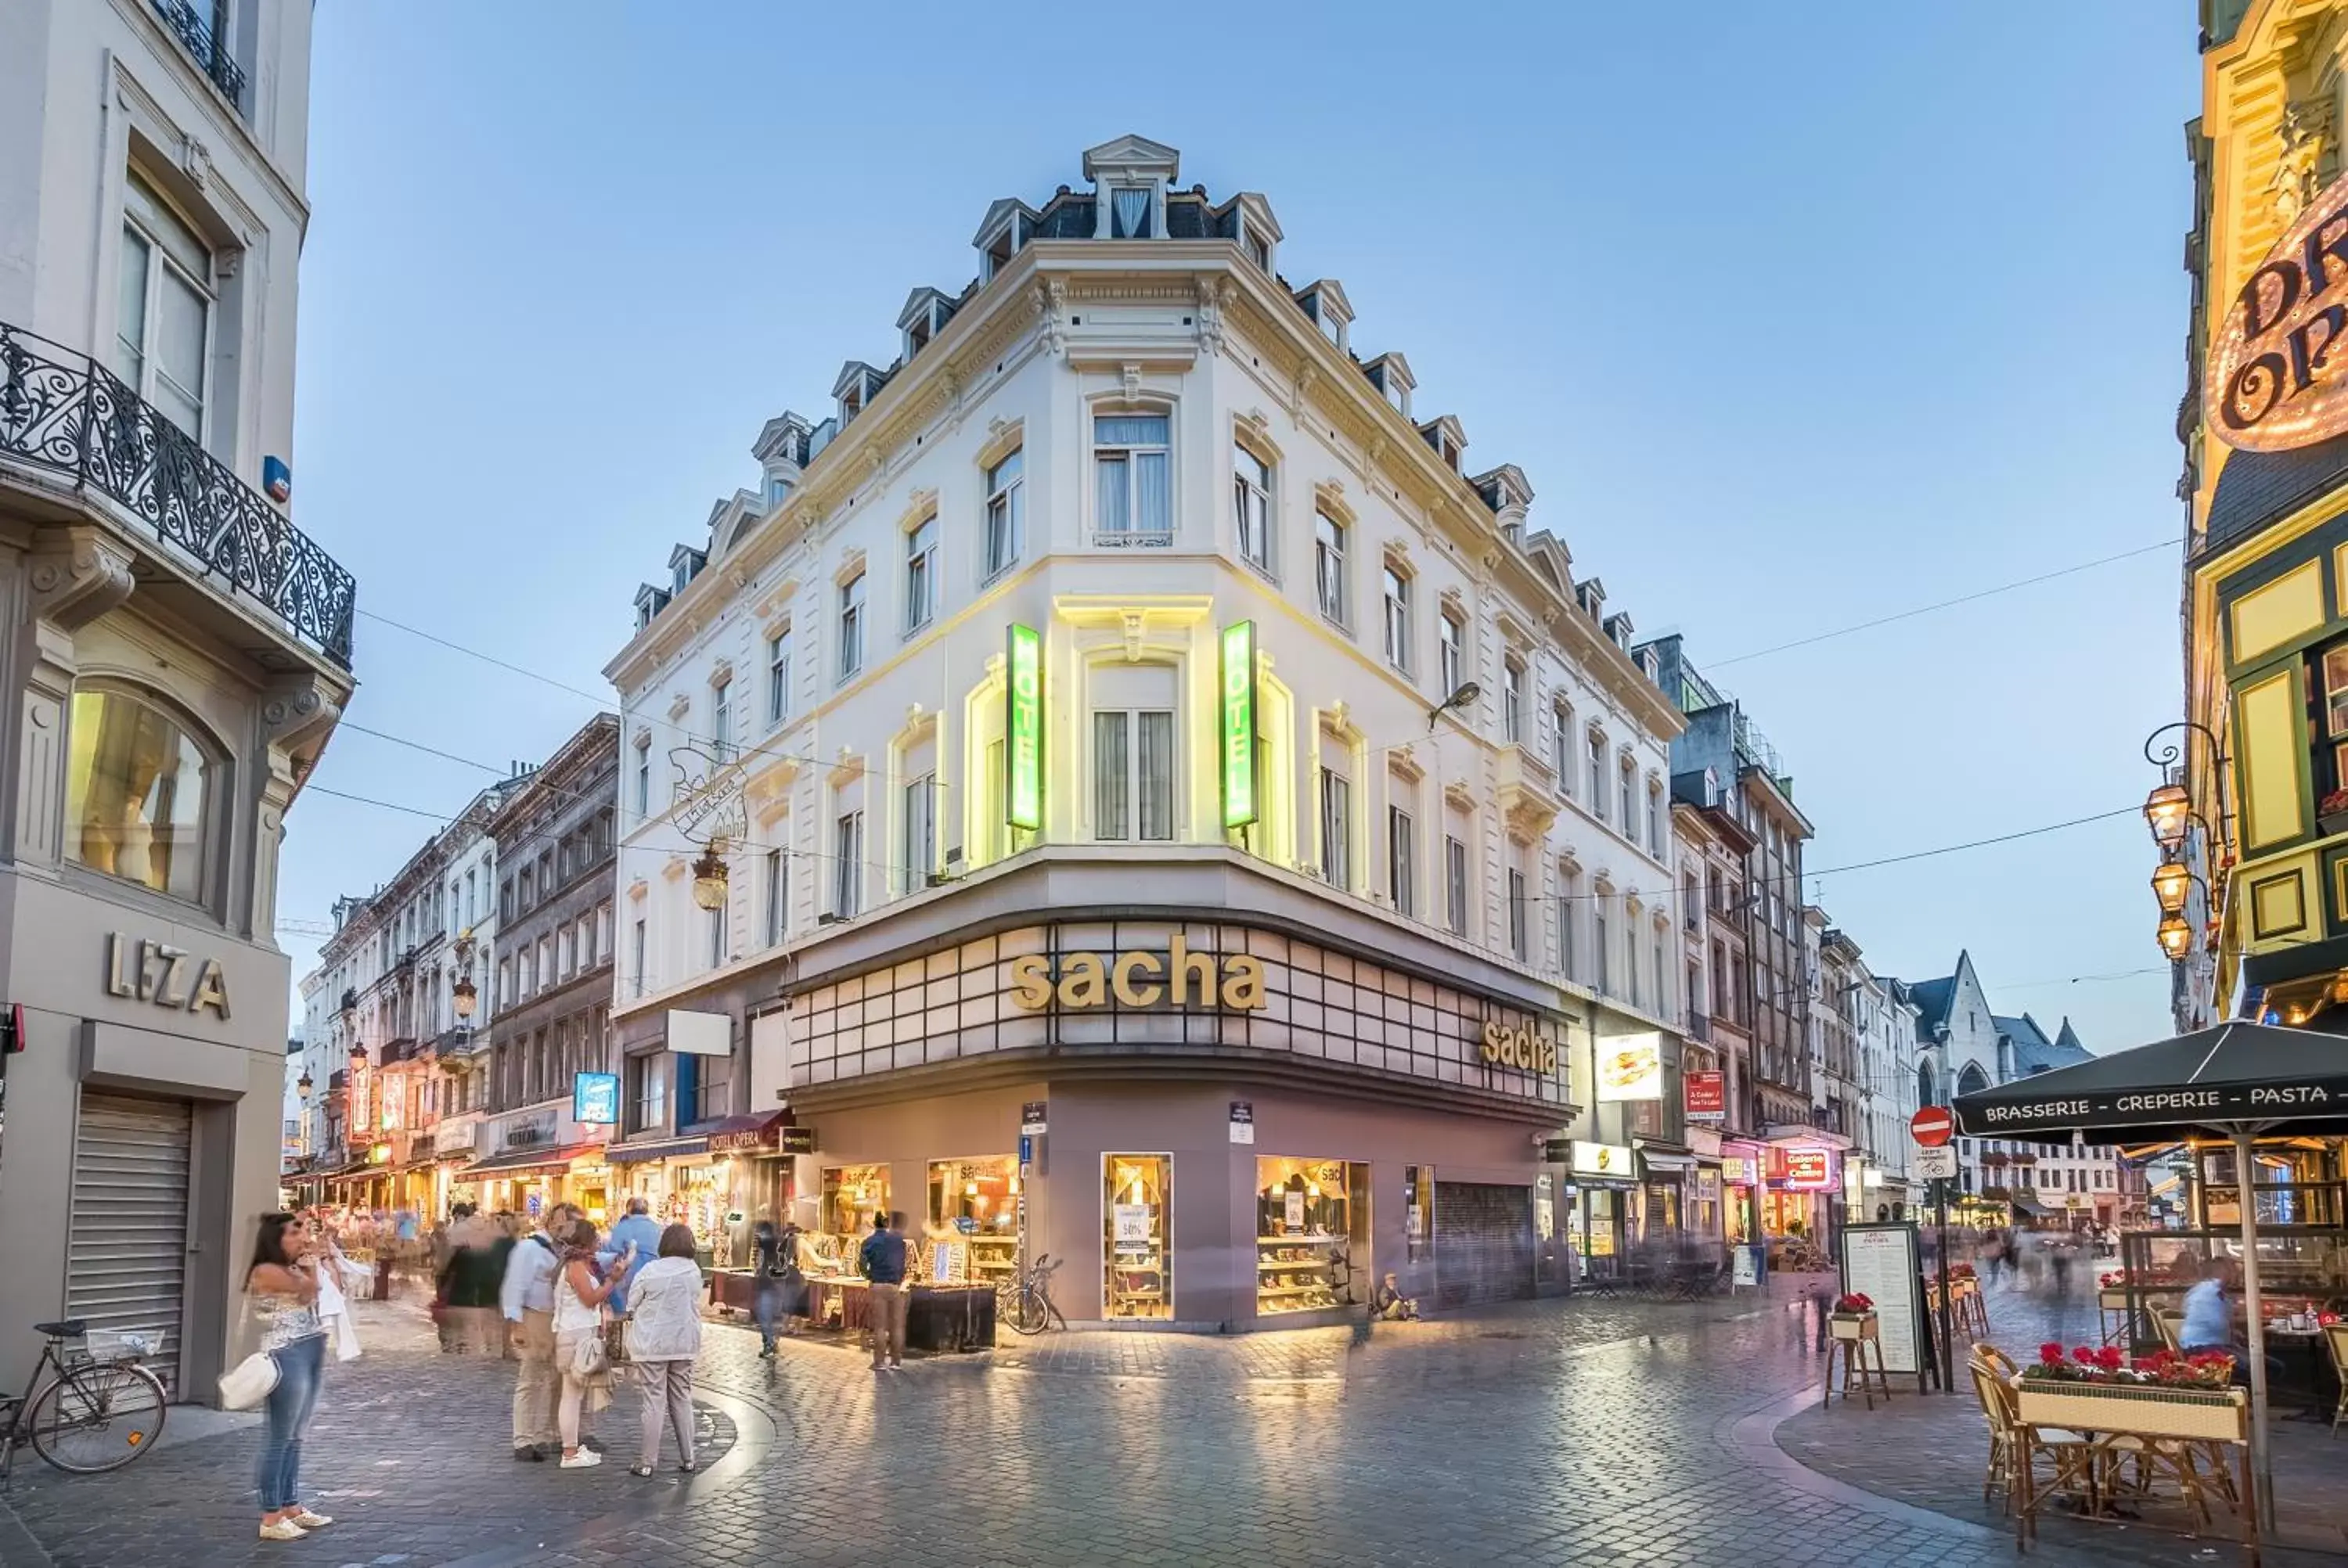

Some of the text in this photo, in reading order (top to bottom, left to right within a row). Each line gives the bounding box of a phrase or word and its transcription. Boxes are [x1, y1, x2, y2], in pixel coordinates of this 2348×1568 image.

[1014, 634, 1039, 817] HOTEL
[1226, 632, 1248, 817] HOTEL
[108, 930, 232, 1021] LIZA
[1009, 934, 1268, 1010] sacha
[1480, 1019, 1557, 1076] sacha
[1985, 1100, 2090, 1122] BRASSERIE
[2116, 1091, 2220, 1113] CREPERIE
[2250, 1087, 2328, 1104] PASTA
[710, 1135, 730, 1149] HOTEL
[1788, 1154, 1824, 1164] Galerie
